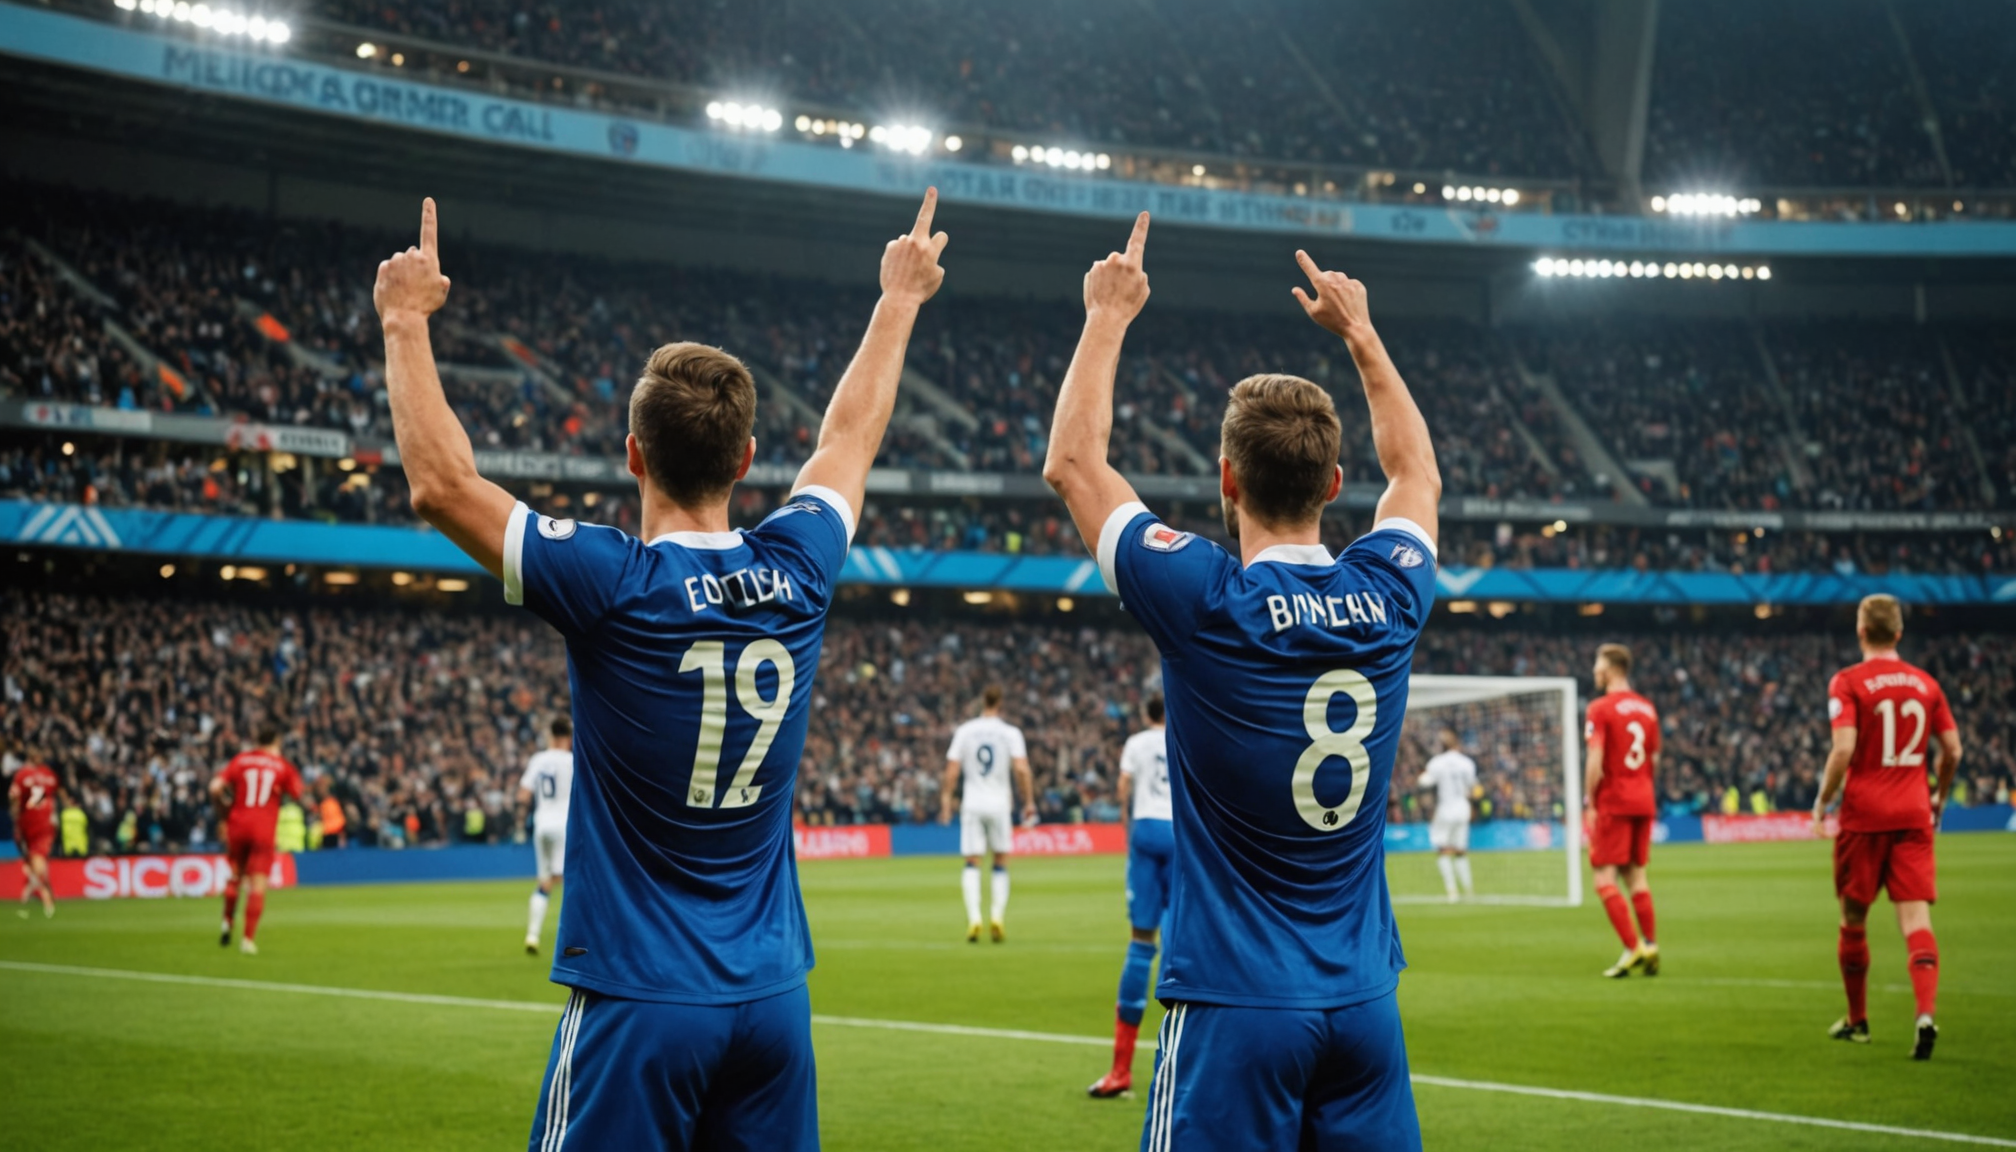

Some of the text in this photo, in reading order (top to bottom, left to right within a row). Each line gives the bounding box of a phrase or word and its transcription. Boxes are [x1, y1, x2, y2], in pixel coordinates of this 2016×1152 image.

[678, 638, 795, 809] 19
[1291, 668, 1377, 832] 8
[1623, 720, 1646, 770] 3
[1873, 697, 1926, 767] 12
[243, 767, 276, 808] 11
[976, 743, 994, 777] 9
